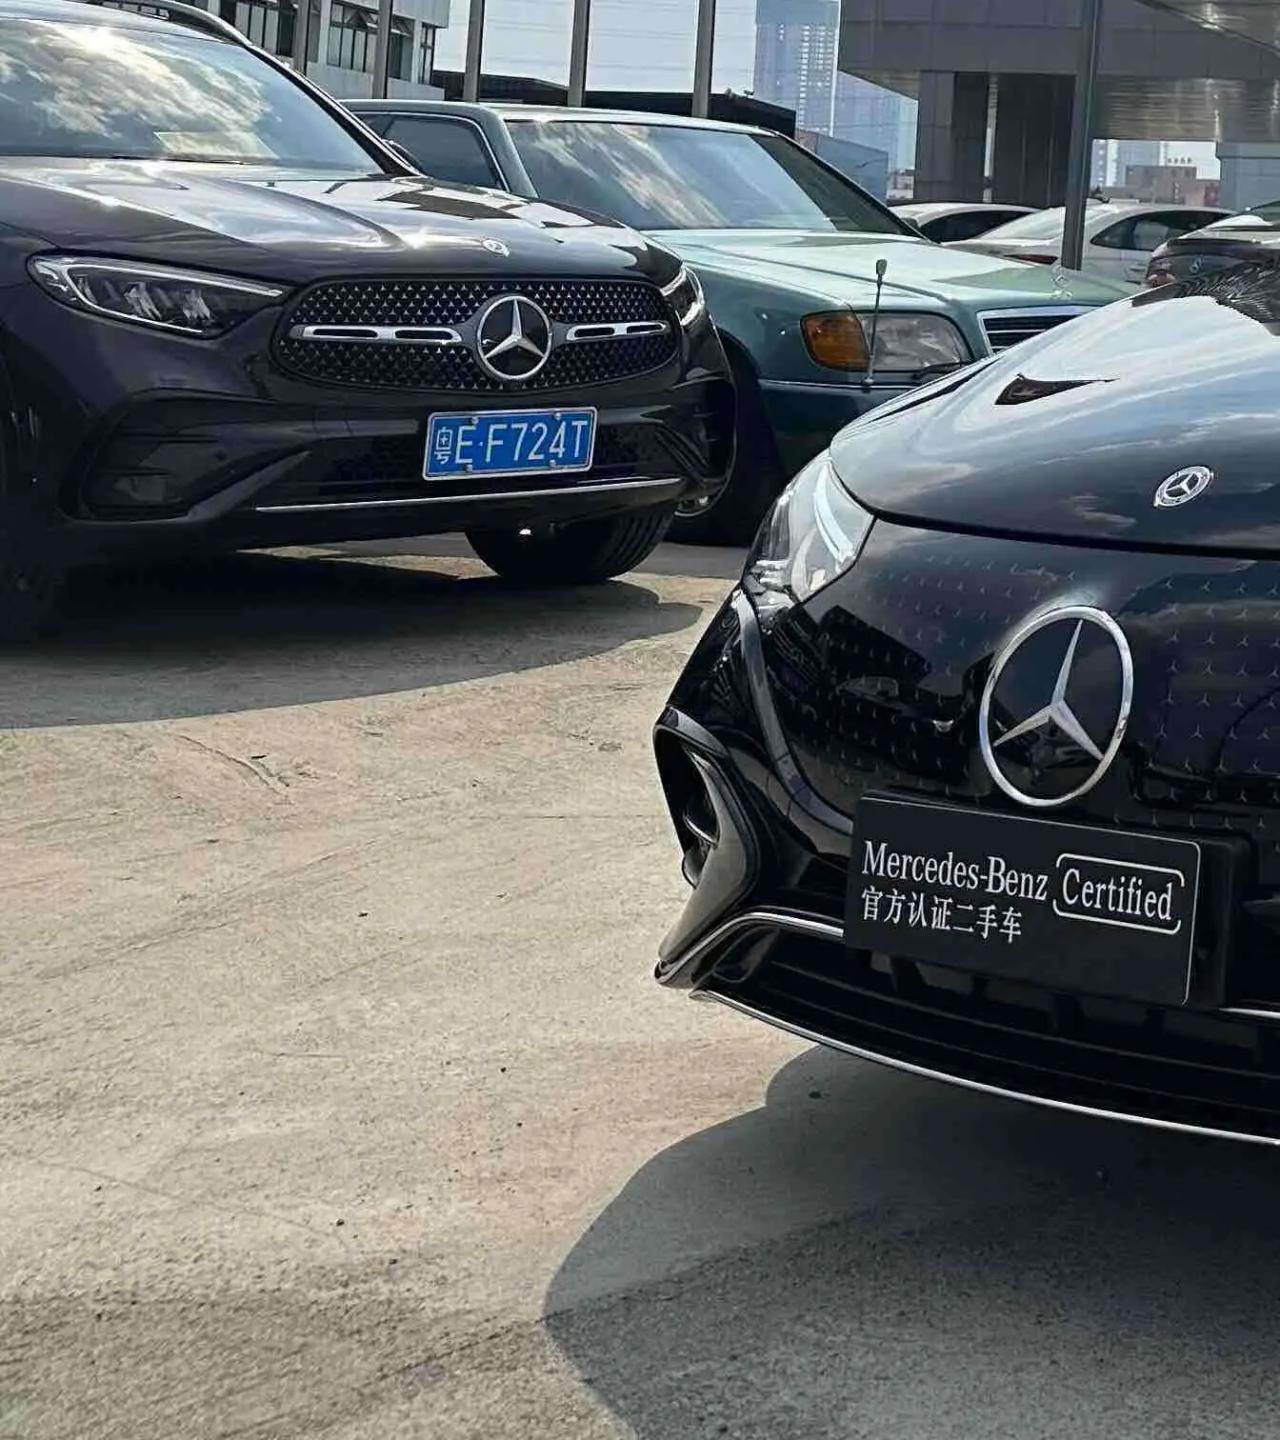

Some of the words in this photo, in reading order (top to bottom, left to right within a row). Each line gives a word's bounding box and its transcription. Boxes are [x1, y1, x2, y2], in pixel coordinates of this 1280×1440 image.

[862, 840, 1048, 900] Mercedes-Benz
[1062, 868, 1173, 920] Certified
[861, 886, 1022, 943] 官方认证二手车
